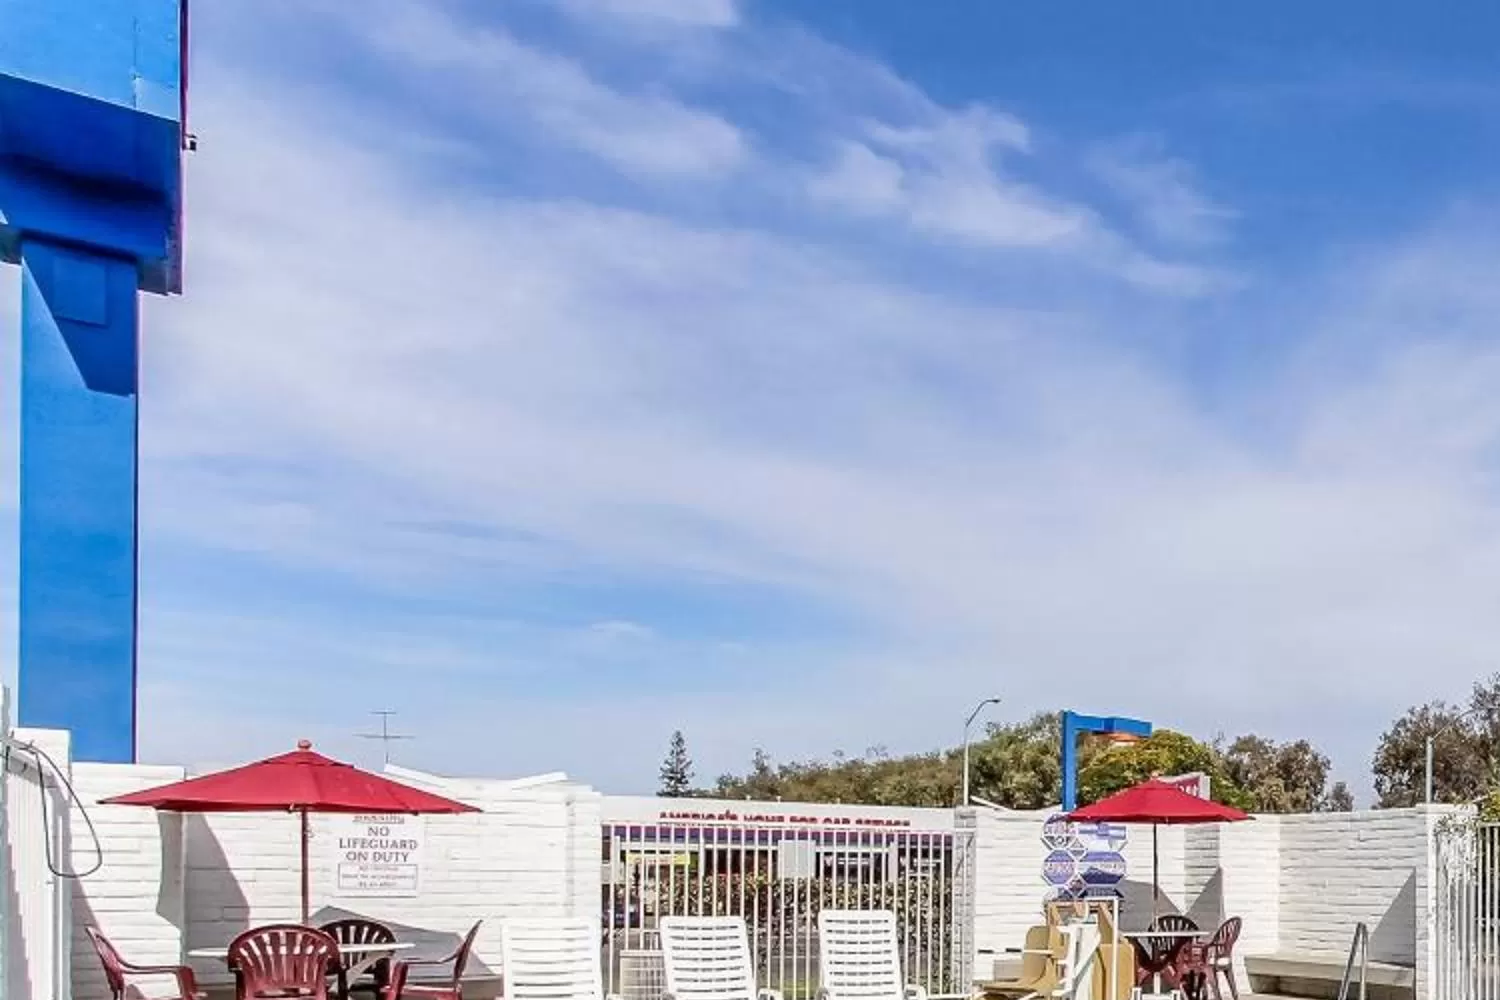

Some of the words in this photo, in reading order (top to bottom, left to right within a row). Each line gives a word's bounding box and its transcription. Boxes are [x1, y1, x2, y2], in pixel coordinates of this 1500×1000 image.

[367, 826, 390, 837] NO
[339, 838, 418, 850] LIFEGUARD
[345, 851, 369, 861] ON
[372, 851, 410, 862] DUTY
